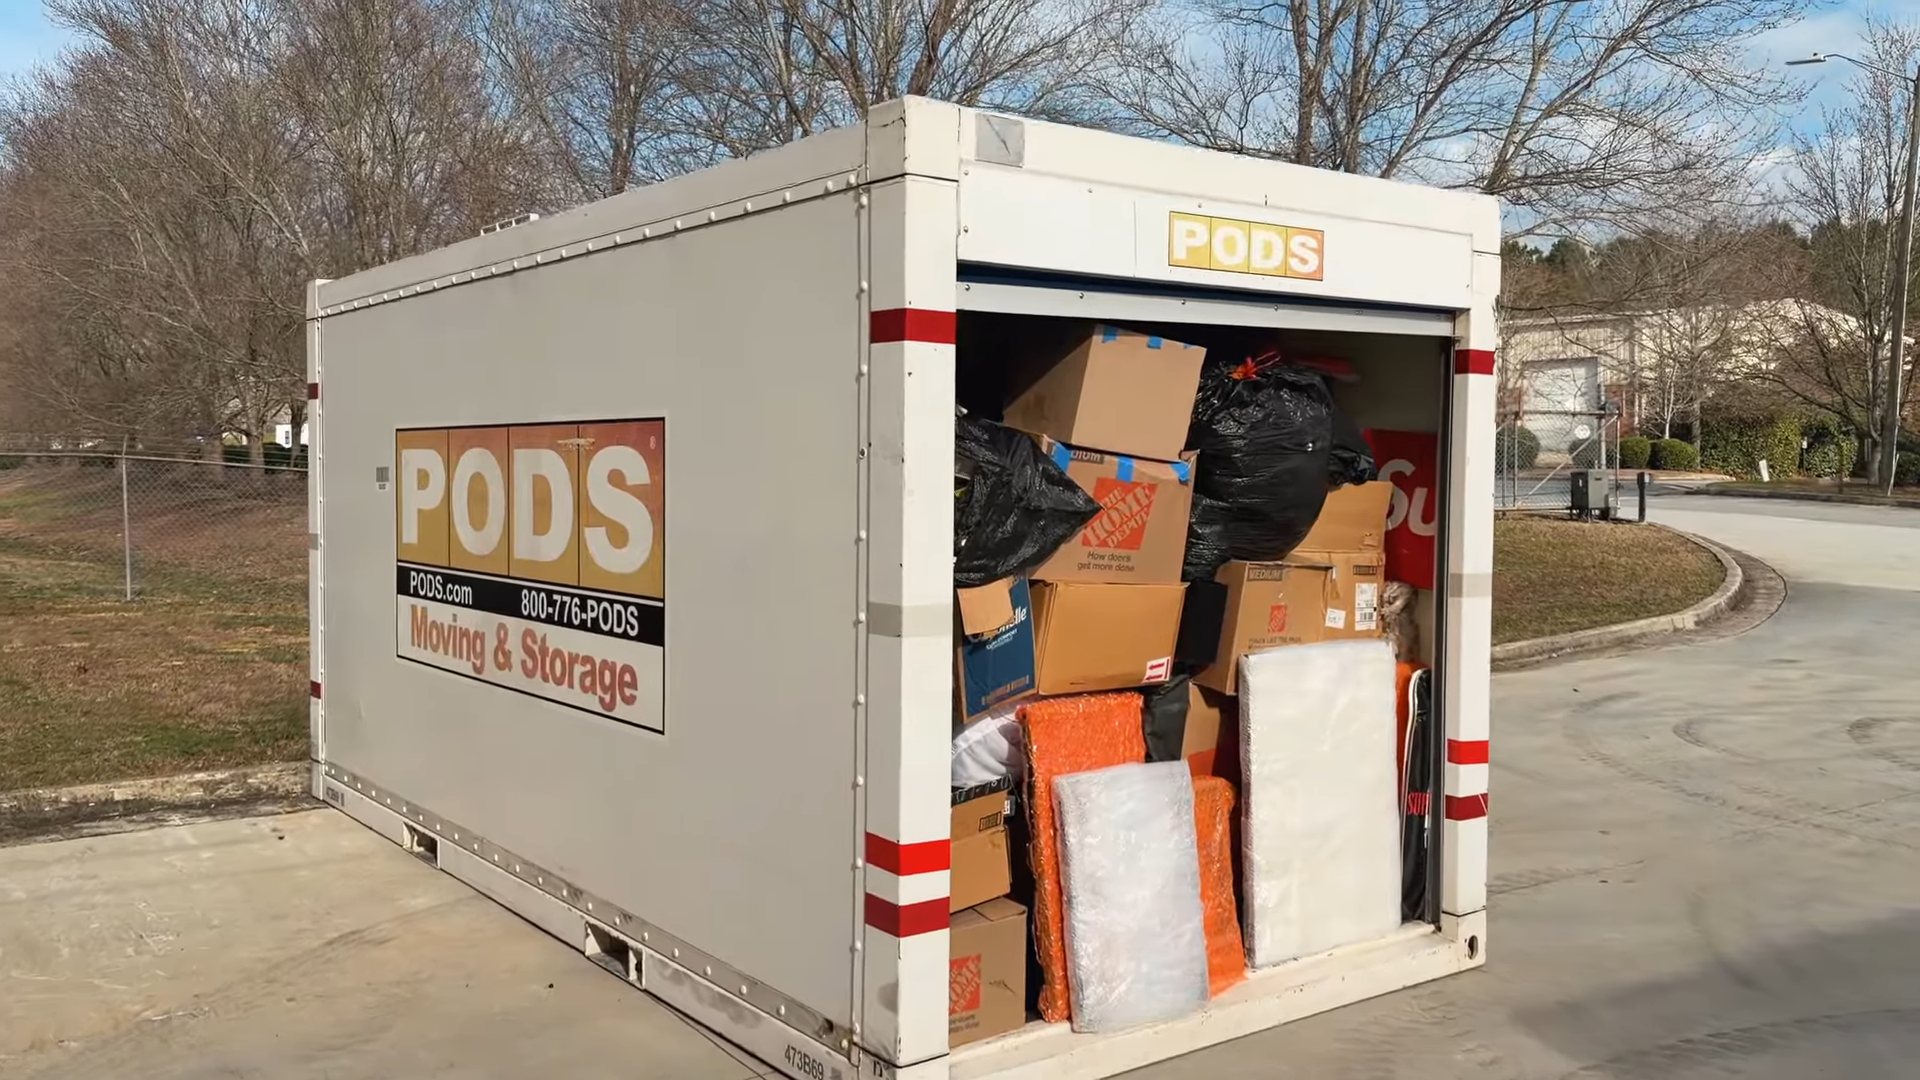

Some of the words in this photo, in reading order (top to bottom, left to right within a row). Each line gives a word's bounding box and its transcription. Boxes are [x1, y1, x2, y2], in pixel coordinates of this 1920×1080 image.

[1173, 219, 1319, 273] PODS
[401, 446, 654, 574] PODS
[1082, 482, 1154, 547] HOME
[1077, 561, 1092, 571] get
[1093, 562, 1113, 571] more
[1115, 563, 1134, 572] done
[1087, 551, 1106, 562] How
[1107, 552, 1131, 562] doers
[1250, 569, 1281, 580] MEDIUM
[410, 571, 472, 605] PODS.com
[521, 589, 638, 637] 800-776-PODS
[410, 604, 485, 675] Moving
[494, 622, 512, 672] &
[521, 627, 638, 712] Storage
[784, 1043, 824, 1080] 473B69
